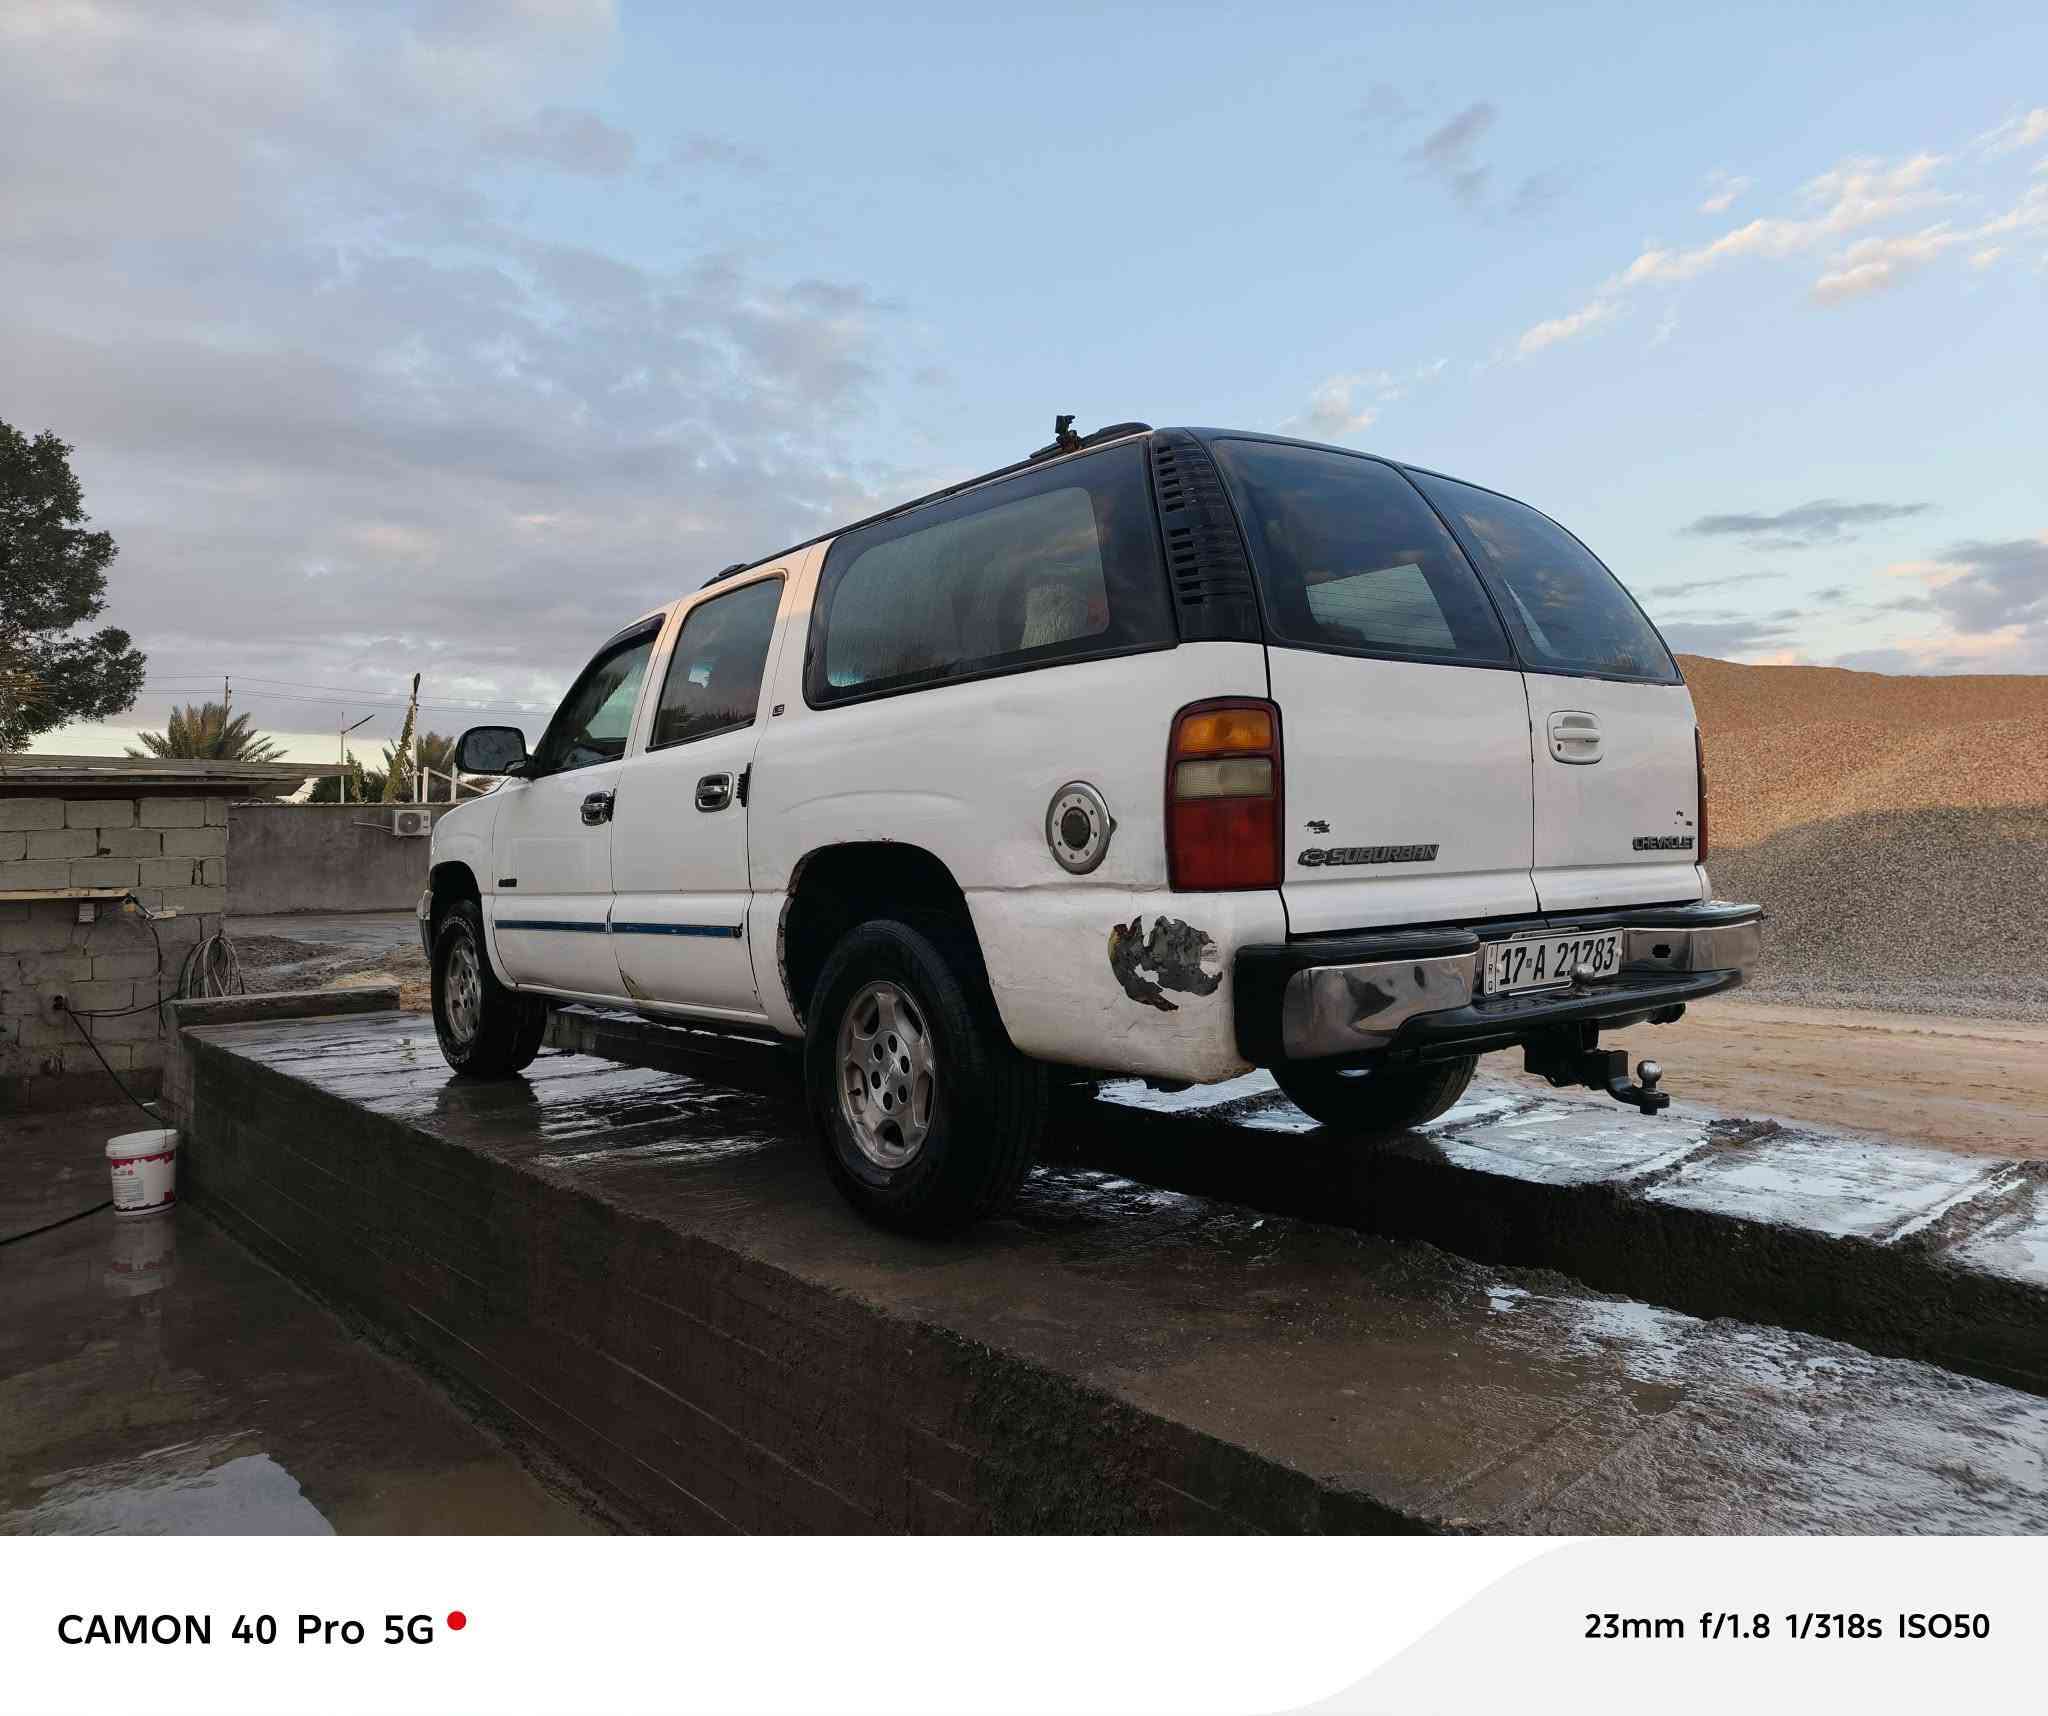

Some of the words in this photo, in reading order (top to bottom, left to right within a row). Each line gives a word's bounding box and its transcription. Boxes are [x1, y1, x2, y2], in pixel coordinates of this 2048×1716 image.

[1633, 835, 1695, 850] CHEVROLET
[1328, 844, 1439, 866] SUBURBAN
[1554, 937, 1616, 978] 21783
